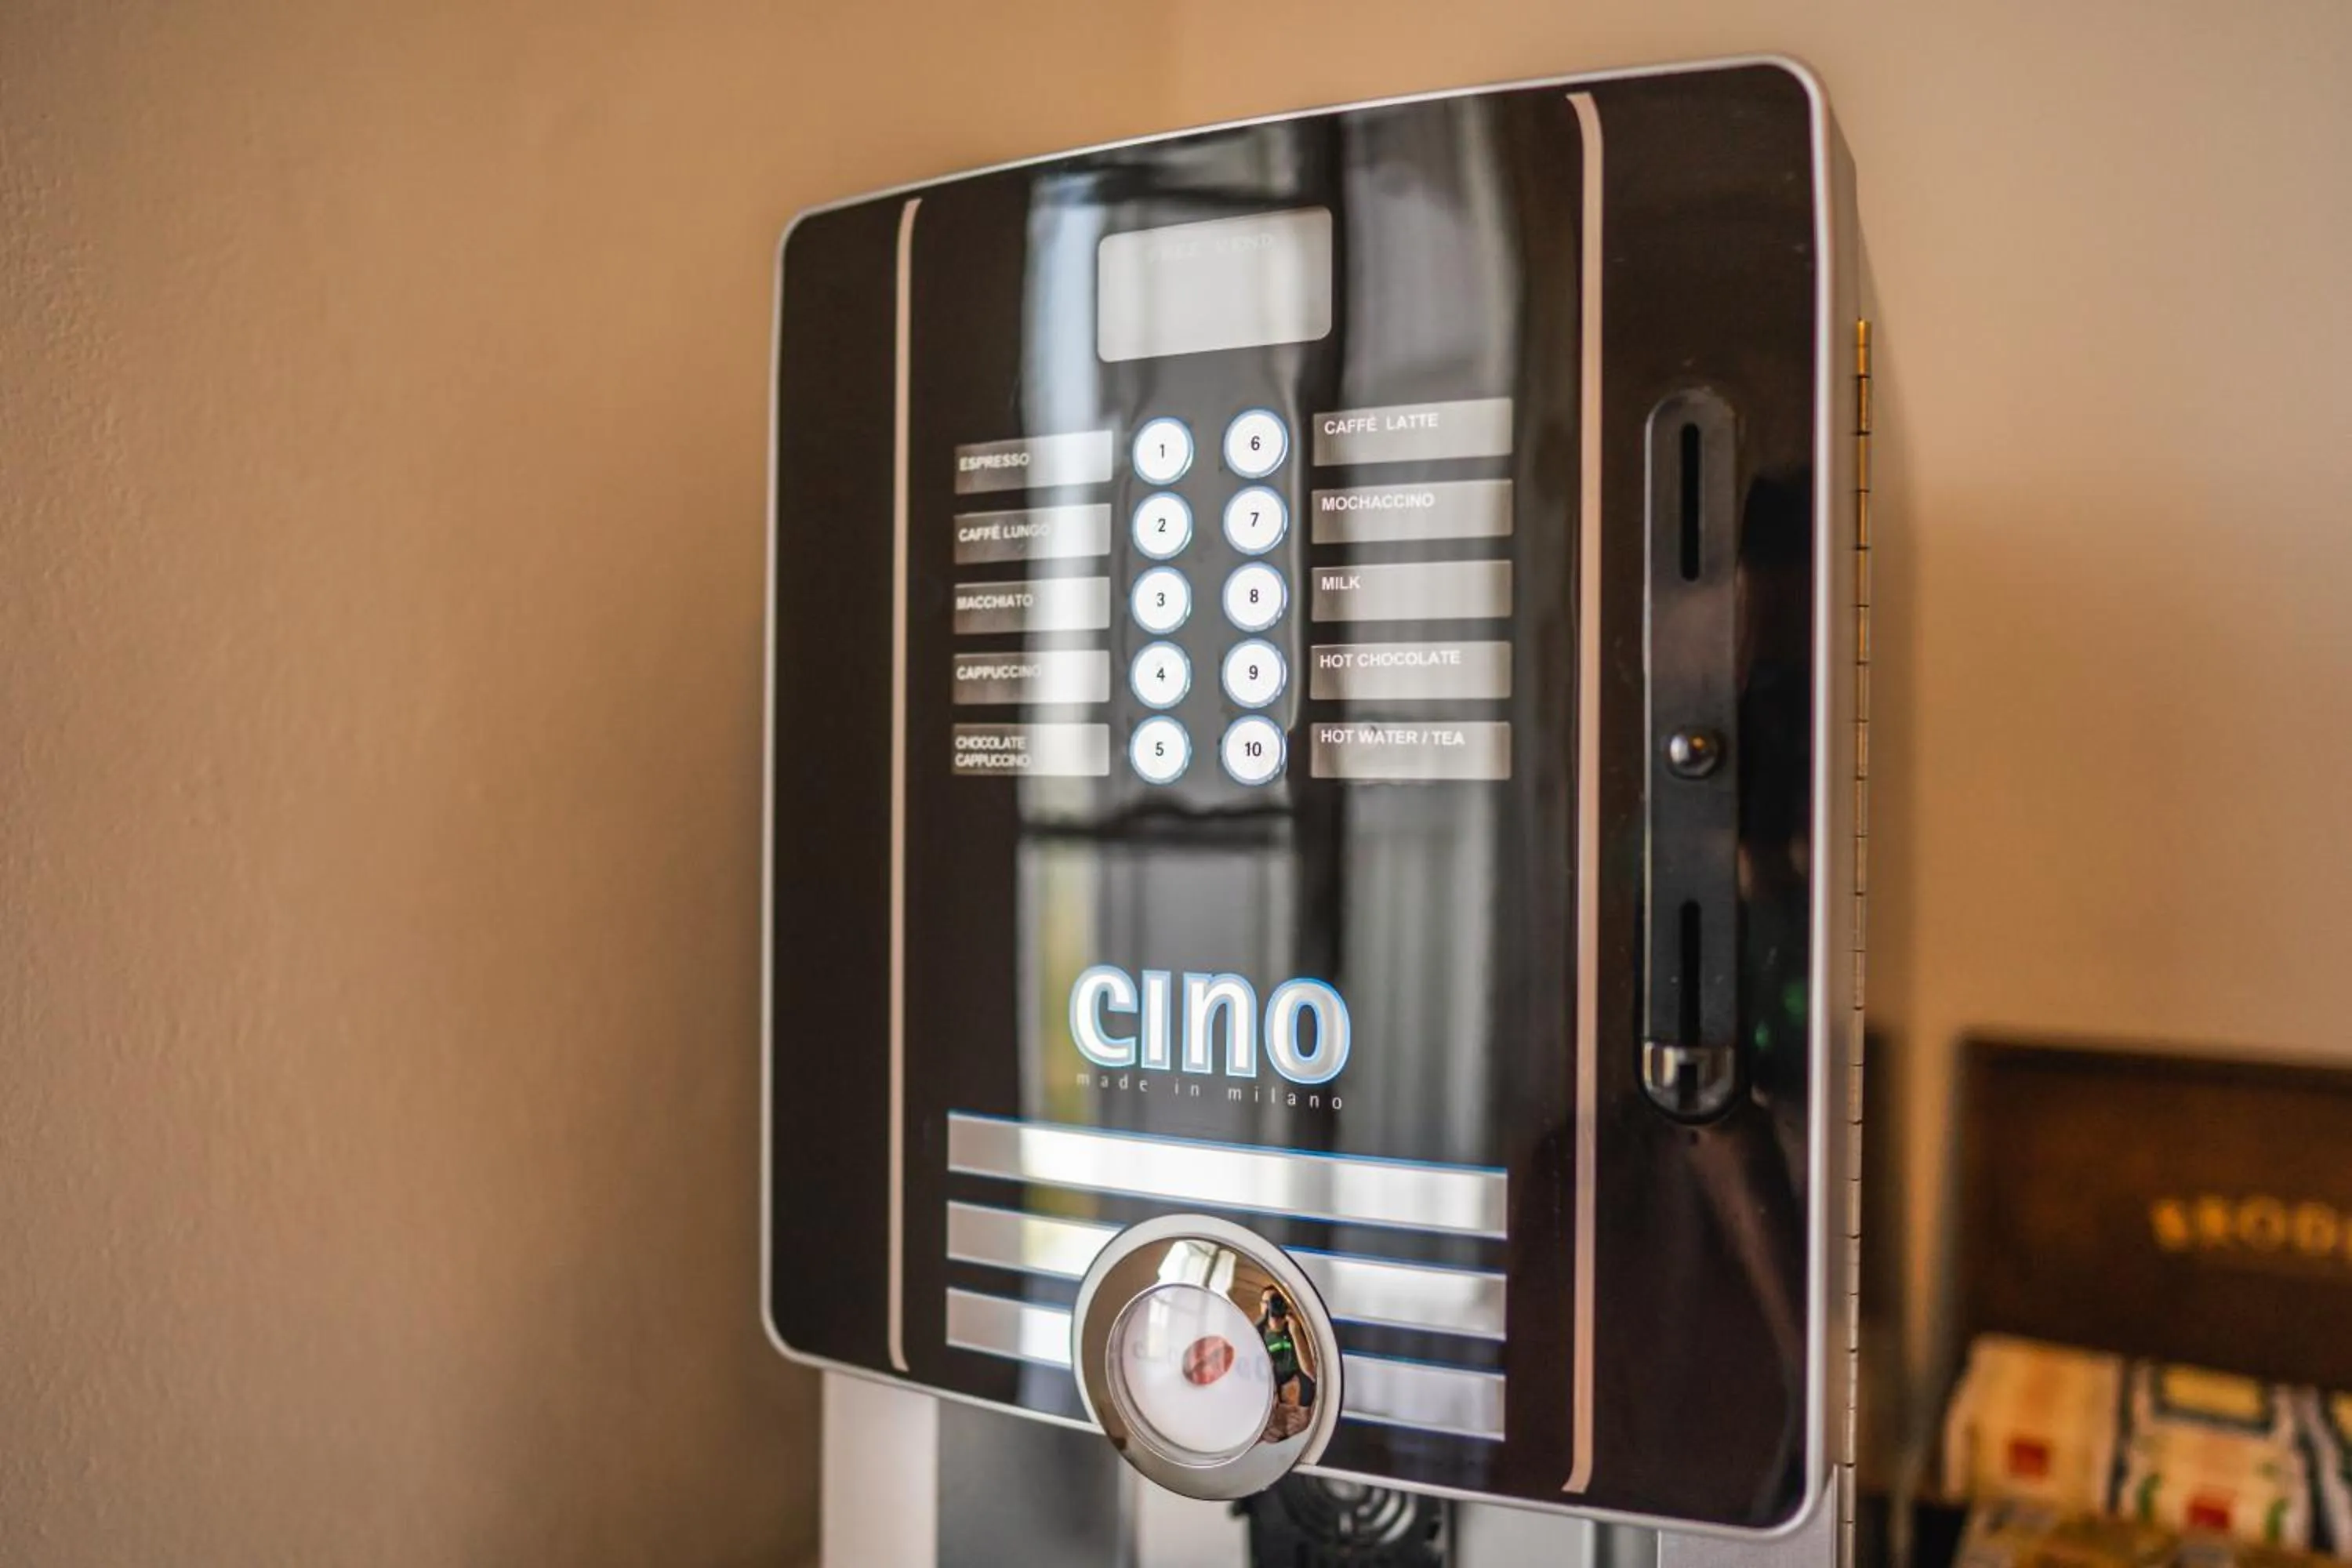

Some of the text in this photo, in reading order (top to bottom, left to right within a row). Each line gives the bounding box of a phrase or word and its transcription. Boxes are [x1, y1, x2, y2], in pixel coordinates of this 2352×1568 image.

[1386, 413, 1439, 431] LATTE
[1160, 445, 1164, 457] 1
[1251, 436, 1260, 451] 6
[959, 452, 1031, 471] ESPRESSO
[1322, 493, 1436, 512] MOCHACCINO
[1159, 518, 1165, 532] 2
[1250, 512, 1259, 527] 7
[1003, 523, 1051, 539] LUNGO
[1321, 576, 1361, 590] MILK
[956, 593, 1034, 611] MACCHIATO
[1157, 593, 1164, 607] 3
[1250, 589, 1258, 603] 8
[1319, 650, 1461, 669] HOT CHOCOLATE
[956, 664, 1042, 681] CAPPUCCINO
[1156, 668, 1165, 681] 4
[1249, 665, 1258, 680] 9
[955, 735, 1026, 750] CHOCOLATE
[1320, 729, 1465, 746] HOT WATER / TEA
[1156, 742, 1163, 756] 5
[1245, 742, 1261, 757] 10
[955, 753, 1032, 768] CAPPUCCINO
[1069, 964, 1351, 1084] cino
[1076, 1072, 1342, 1110] made in milano
